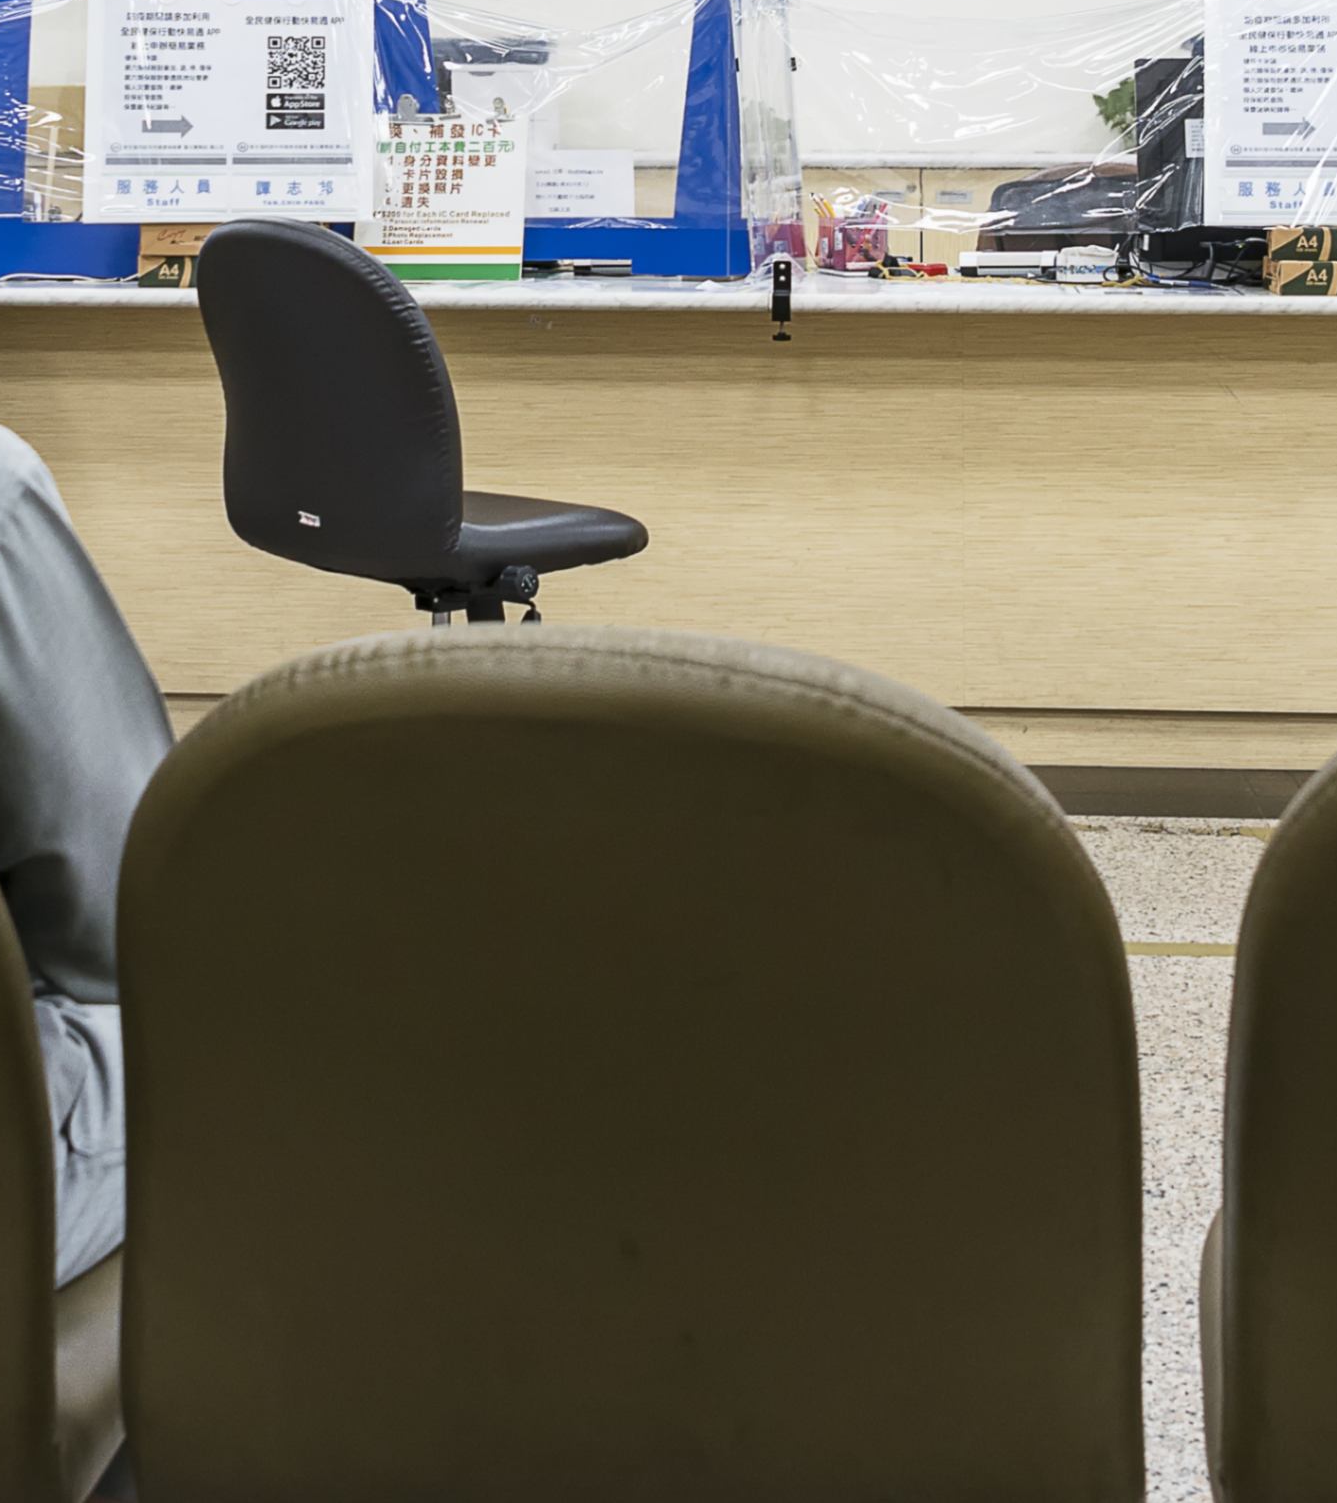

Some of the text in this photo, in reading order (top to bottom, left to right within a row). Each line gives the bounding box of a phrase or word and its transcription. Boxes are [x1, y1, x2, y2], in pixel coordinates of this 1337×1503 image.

[395, 168, 464, 181] .卡片毀損
[116, 179, 213, 195] 服務人員
[146, 198, 180, 207] Staff
[1269, 200, 1304, 209] Staff
[416, 210, 438, 218] Each
[449, 210, 470, 218] Card
[471, 210, 511, 219] Replaced
[1296, 235, 1318, 248] A4
[158, 263, 179, 277] A4
[1306, 268, 1328, 282] A4
